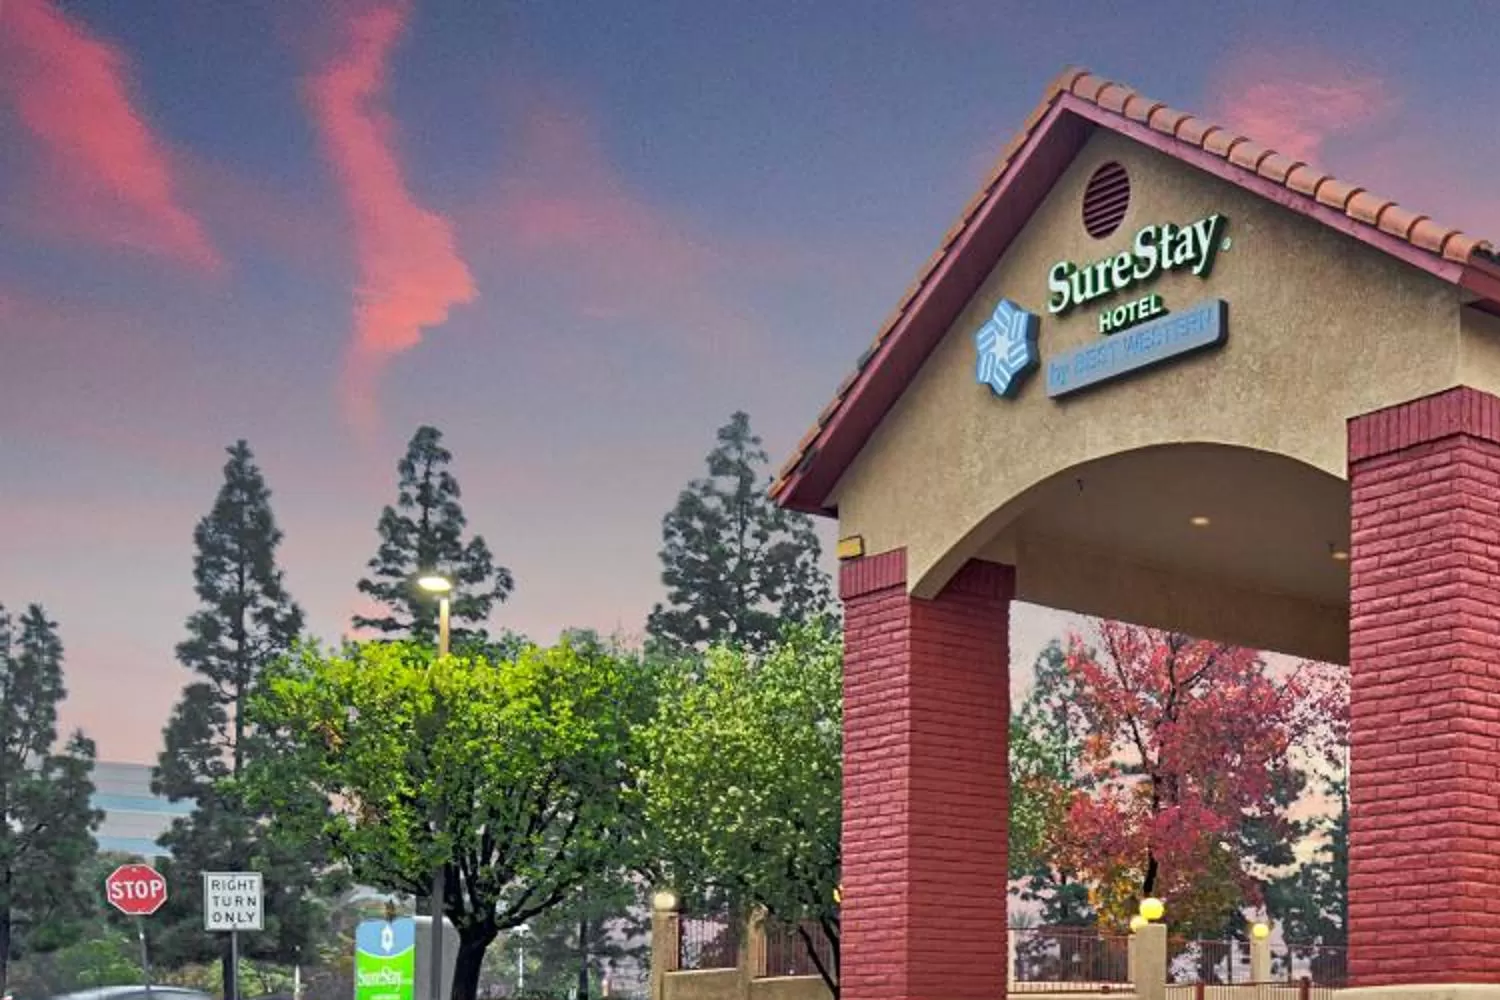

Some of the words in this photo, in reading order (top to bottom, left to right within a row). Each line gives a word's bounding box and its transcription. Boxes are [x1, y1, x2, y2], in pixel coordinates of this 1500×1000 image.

[1048, 212, 1222, 314] SureStay
[1099, 293, 1163, 333] HOTEL
[1075, 339, 1118, 374] BEST
[1123, 307, 1214, 354] WESTERN
[111, 879, 163, 899] STOP
[211, 879, 256, 891] RIGHT
[212, 895, 257, 907] TURN
[212, 911, 256, 923] ONLY
